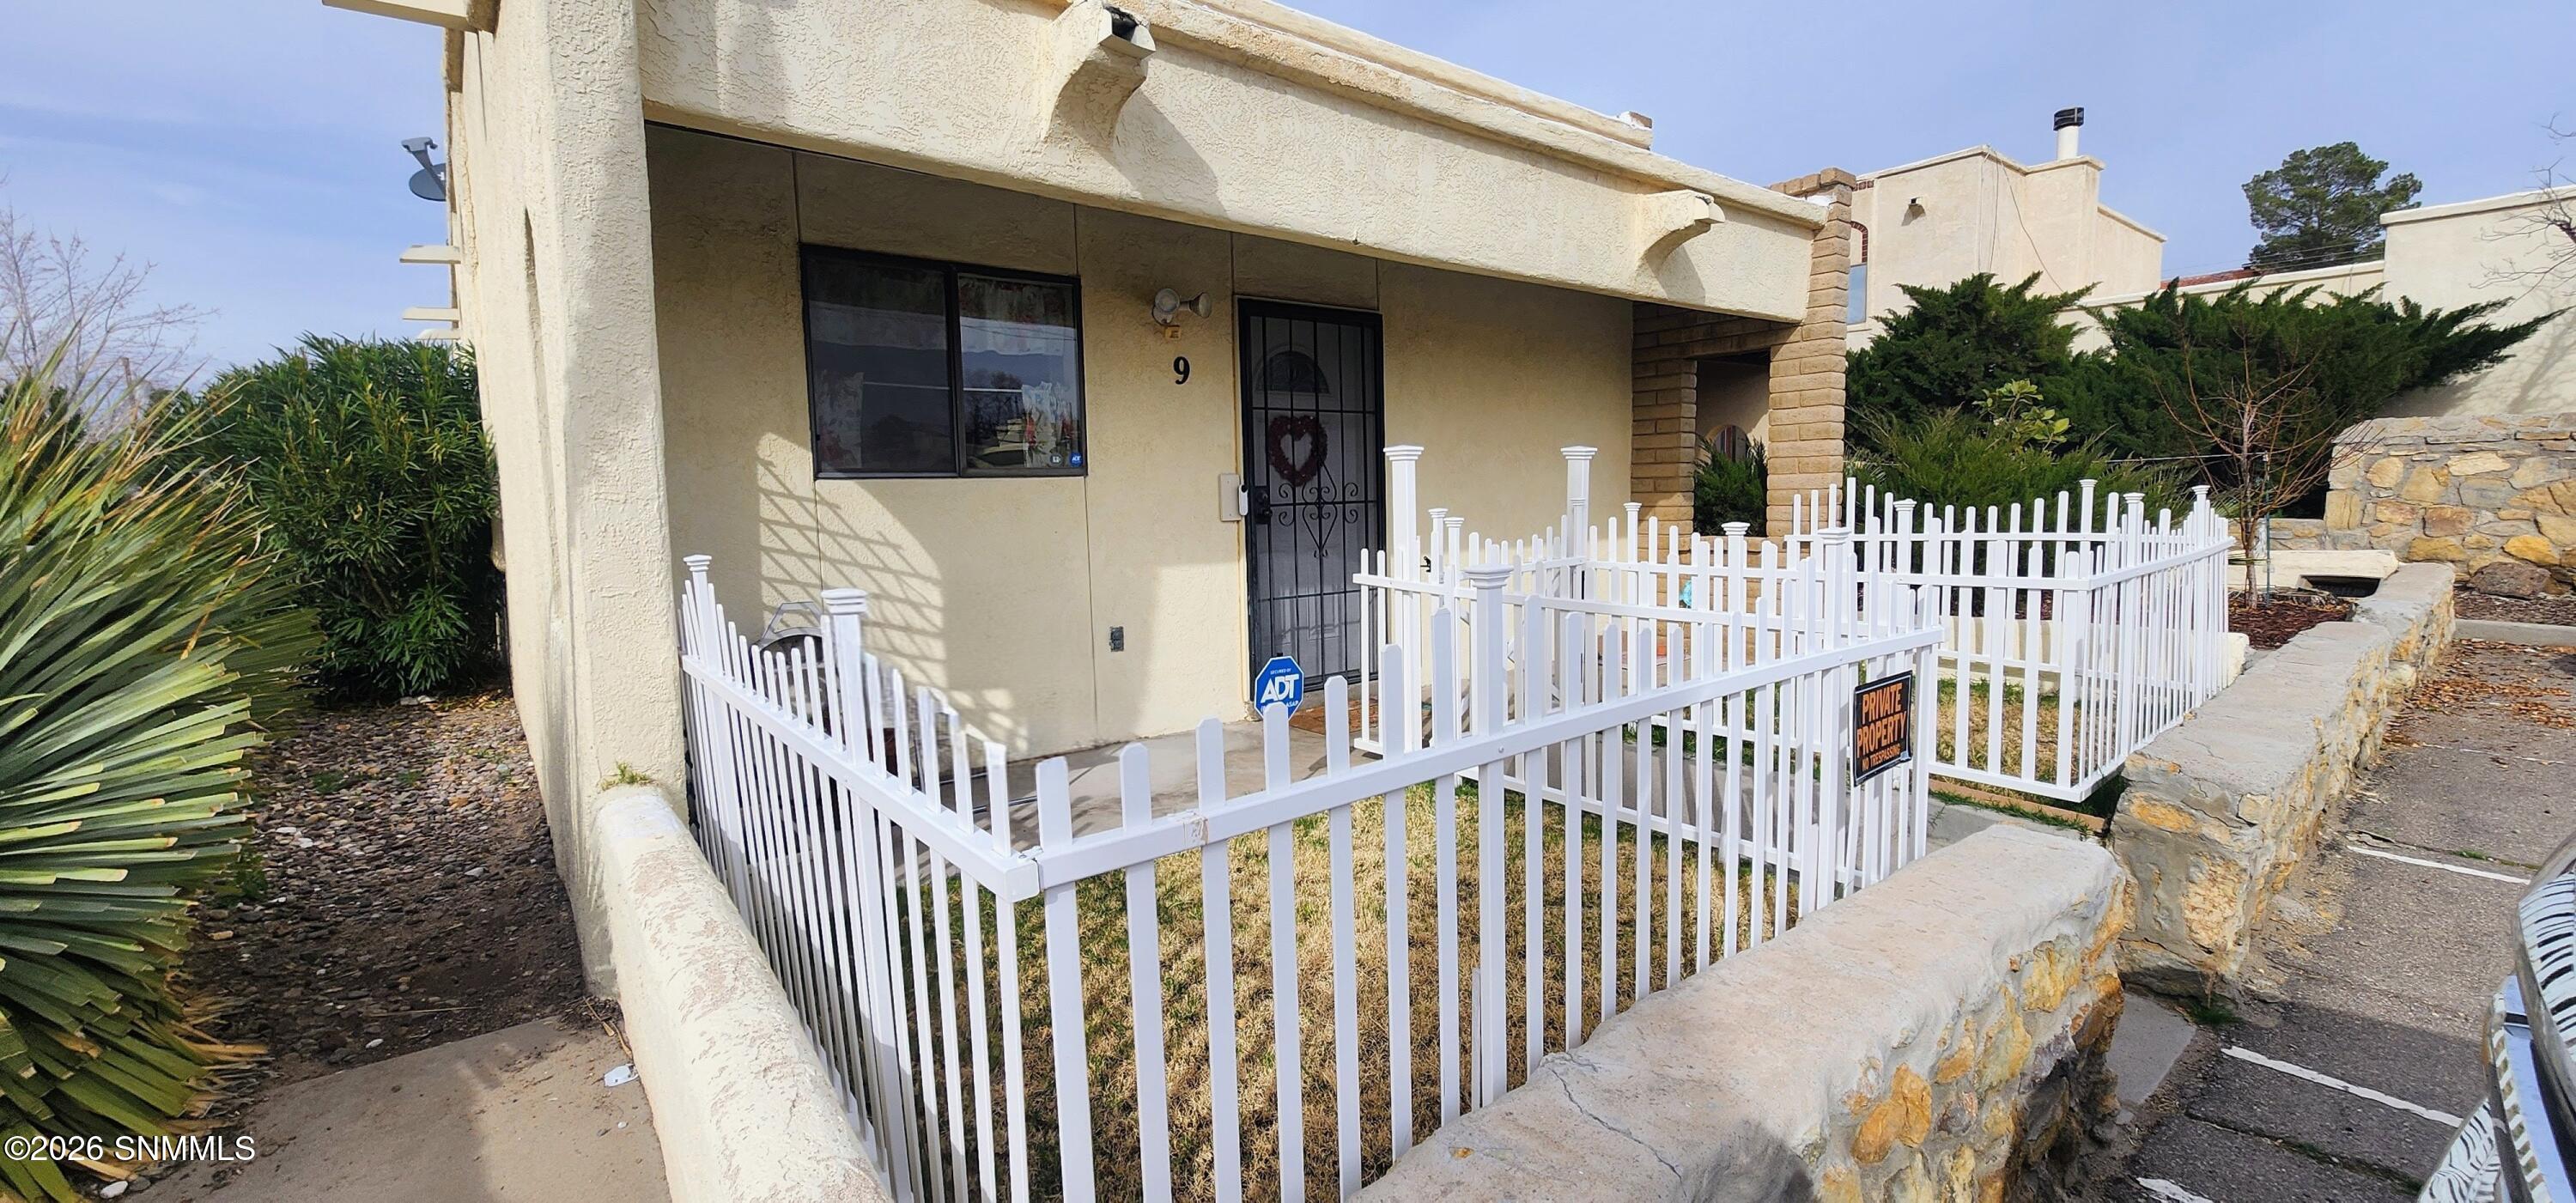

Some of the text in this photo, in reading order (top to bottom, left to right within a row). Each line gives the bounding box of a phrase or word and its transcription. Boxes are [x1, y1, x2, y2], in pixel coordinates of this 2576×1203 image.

[1173, 356, 1190, 385] 9
[1261, 674, 1299, 703] ADT
[1862, 683, 1902, 725] PRIVATE
[1856, 711, 1907, 758] PROPERTY
[1862, 743, 1901, 772] NO TRESPASSING
